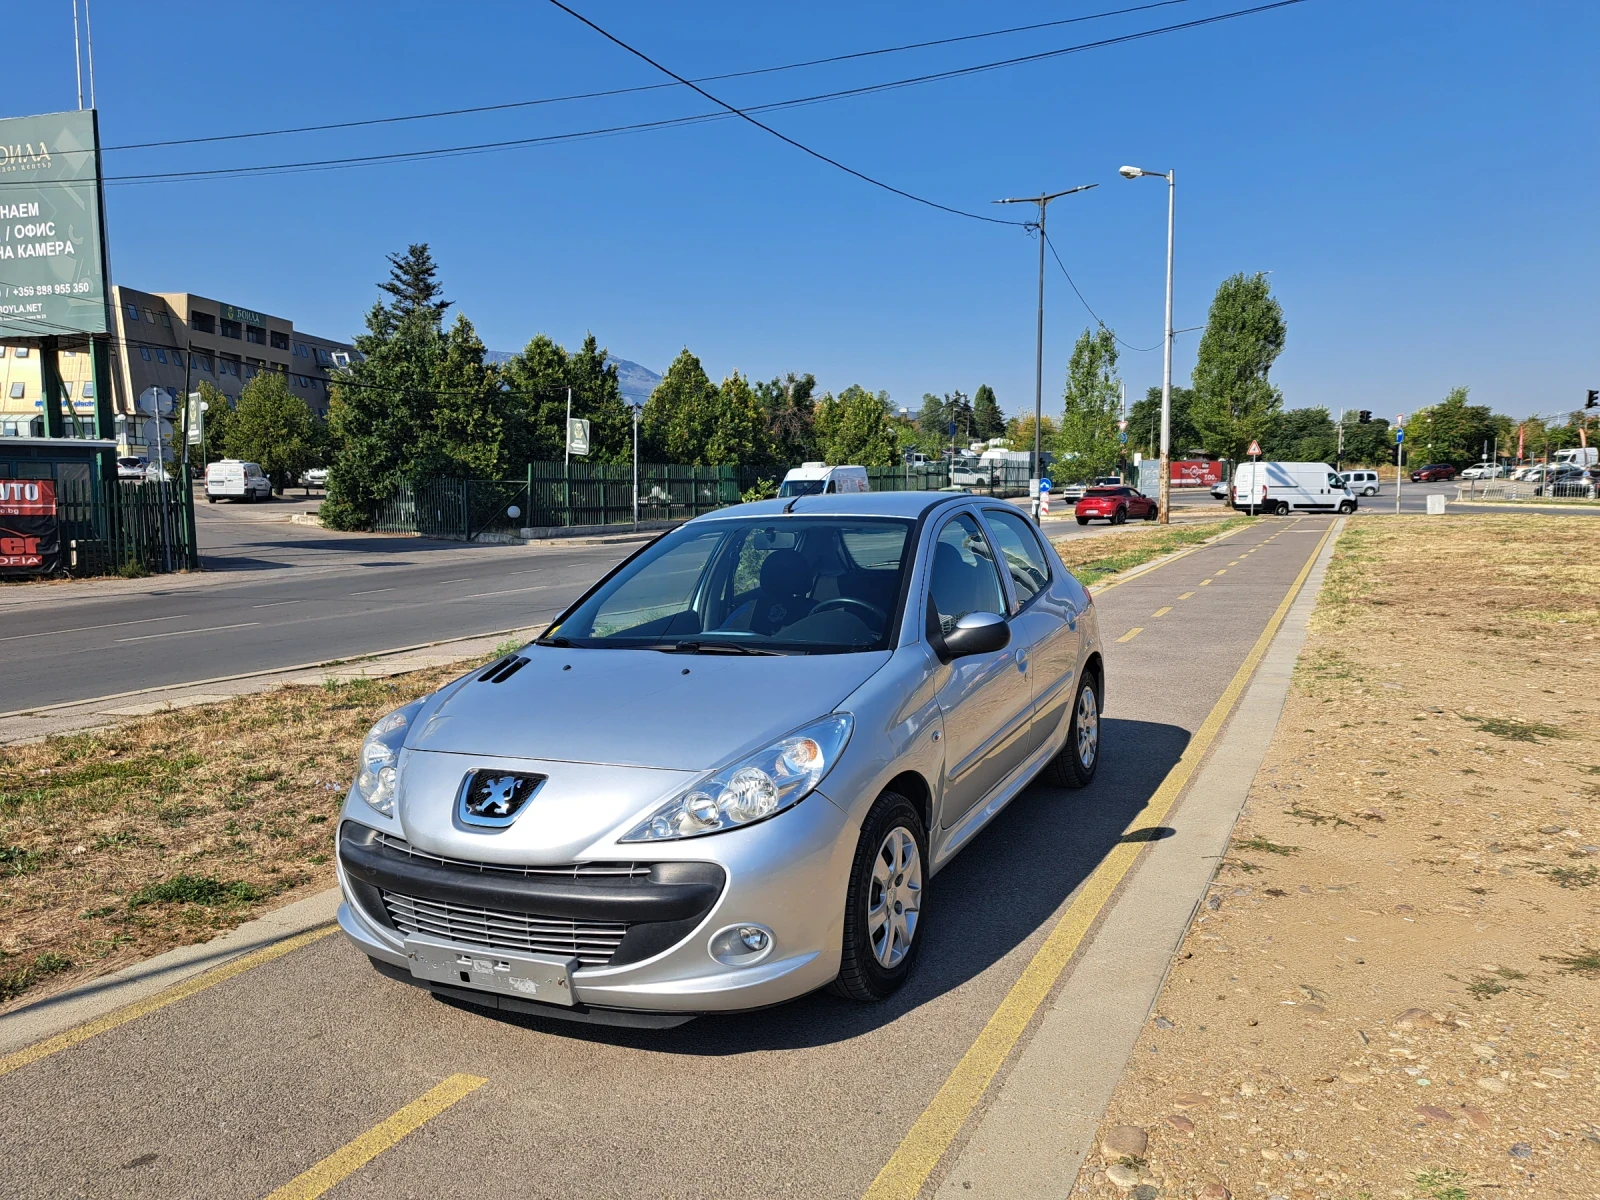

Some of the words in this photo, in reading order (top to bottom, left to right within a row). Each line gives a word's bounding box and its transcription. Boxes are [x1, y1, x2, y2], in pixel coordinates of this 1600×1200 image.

[0, 201, 39, 219] НАЕМ
[14, 221, 56, 239] ОФИС
[17, 240, 75, 258] КАМЕРА
[13, 286, 35, 296] +359
[54, 283, 71, 294] 955
[72, 282, 89, 293] 350
